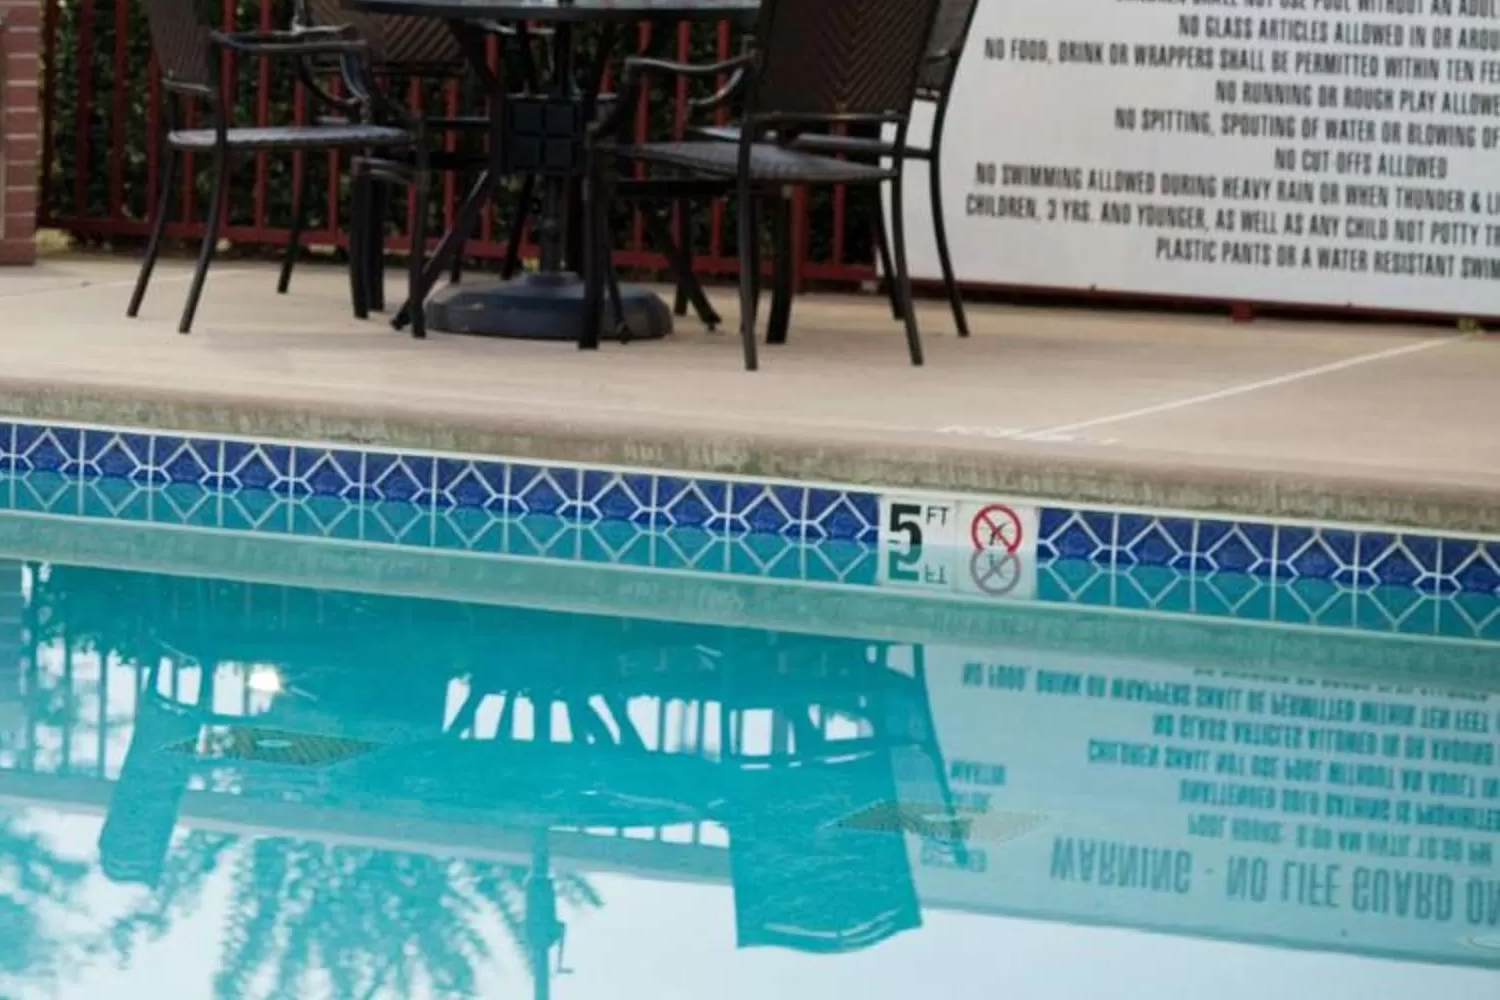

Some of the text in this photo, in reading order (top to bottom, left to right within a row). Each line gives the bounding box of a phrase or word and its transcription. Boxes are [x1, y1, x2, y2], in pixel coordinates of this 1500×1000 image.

[1179, 14, 1199, 38] NO
[1206, 16, 1252, 39] GLASS
[1258, 19, 1328, 43] ARTICLES
[1334, 21, 1404, 47] ALLOWED
[1410, 25, 1426, 48] IN
[1432, 26, 1453, 49] OR
[984, 37, 1005, 60] NO
[1058, 40, 1103, 63] DRINK
[1109, 43, 1128, 65] OR
[1134, 44, 1213, 70] WRAPPERS
[1220, 47, 1265, 72] SHALL
[1272, 50, 1287, 73] BE
[1295, 51, 1380, 78] PERMITTED
[1385, 55, 1440, 80] WITHIN
[1447, 58, 1475, 82] TEN
[1216, 79, 1237, 104] NO
[1243, 81, 1312, 106] RUNNING
[1318, 85, 1338, 108] OR
[1344, 86, 1394, 111] ROUGH
[1400, 88, 1437, 114] PLAY
[1114, 107, 1136, 130] NO
[1221, 112, 1296, 139] SPOUTING
[1302, 116, 1318, 140] OF
[1325, 118, 1376, 143] WATER
[1381, 120, 1402, 145] OR
[1408, 123, 1476, 149] BLOWING
[1482, 126, 1500, 149] OF
[1274, 147, 1297, 171] NO
[1378, 152, 1449, 180] ALLOWED
[976, 161, 997, 185] NO
[1002, 163, 1083, 190] SWIMMING
[1088, 168, 1156, 194] ALLOWED
[1161, 172, 1217, 198] DURING
[1223, 175, 1272, 201] HEAVY
[1277, 178, 1315, 203] RAIN
[1320, 180, 1339, 204] OR
[1346, 183, 1390, 208] WHEN
[1396, 185, 1465, 212] THUNDER
[1101, 201, 1132, 225] AND
[1216, 208, 1235, 231] AS
[1241, 209, 1278, 234] WELL
[1284, 212, 1304, 235] AS
[1310, 214, 1341, 238] ANY
[1345, 215, 1388, 240] CHILD
[1395, 218, 1425, 243] NOT
[1431, 221, 1481, 247] POTTY
[1156, 236, 1217, 262] PLASTIC
[1221, 240, 1272, 267] PANTS
[1277, 244, 1297, 268] OR
[1302, 246, 1311, 268] A
[1317, 247, 1369, 272] WATER
[1374, 250, 1454, 277] RESISTANT
[889, 503, 922, 552] 5
